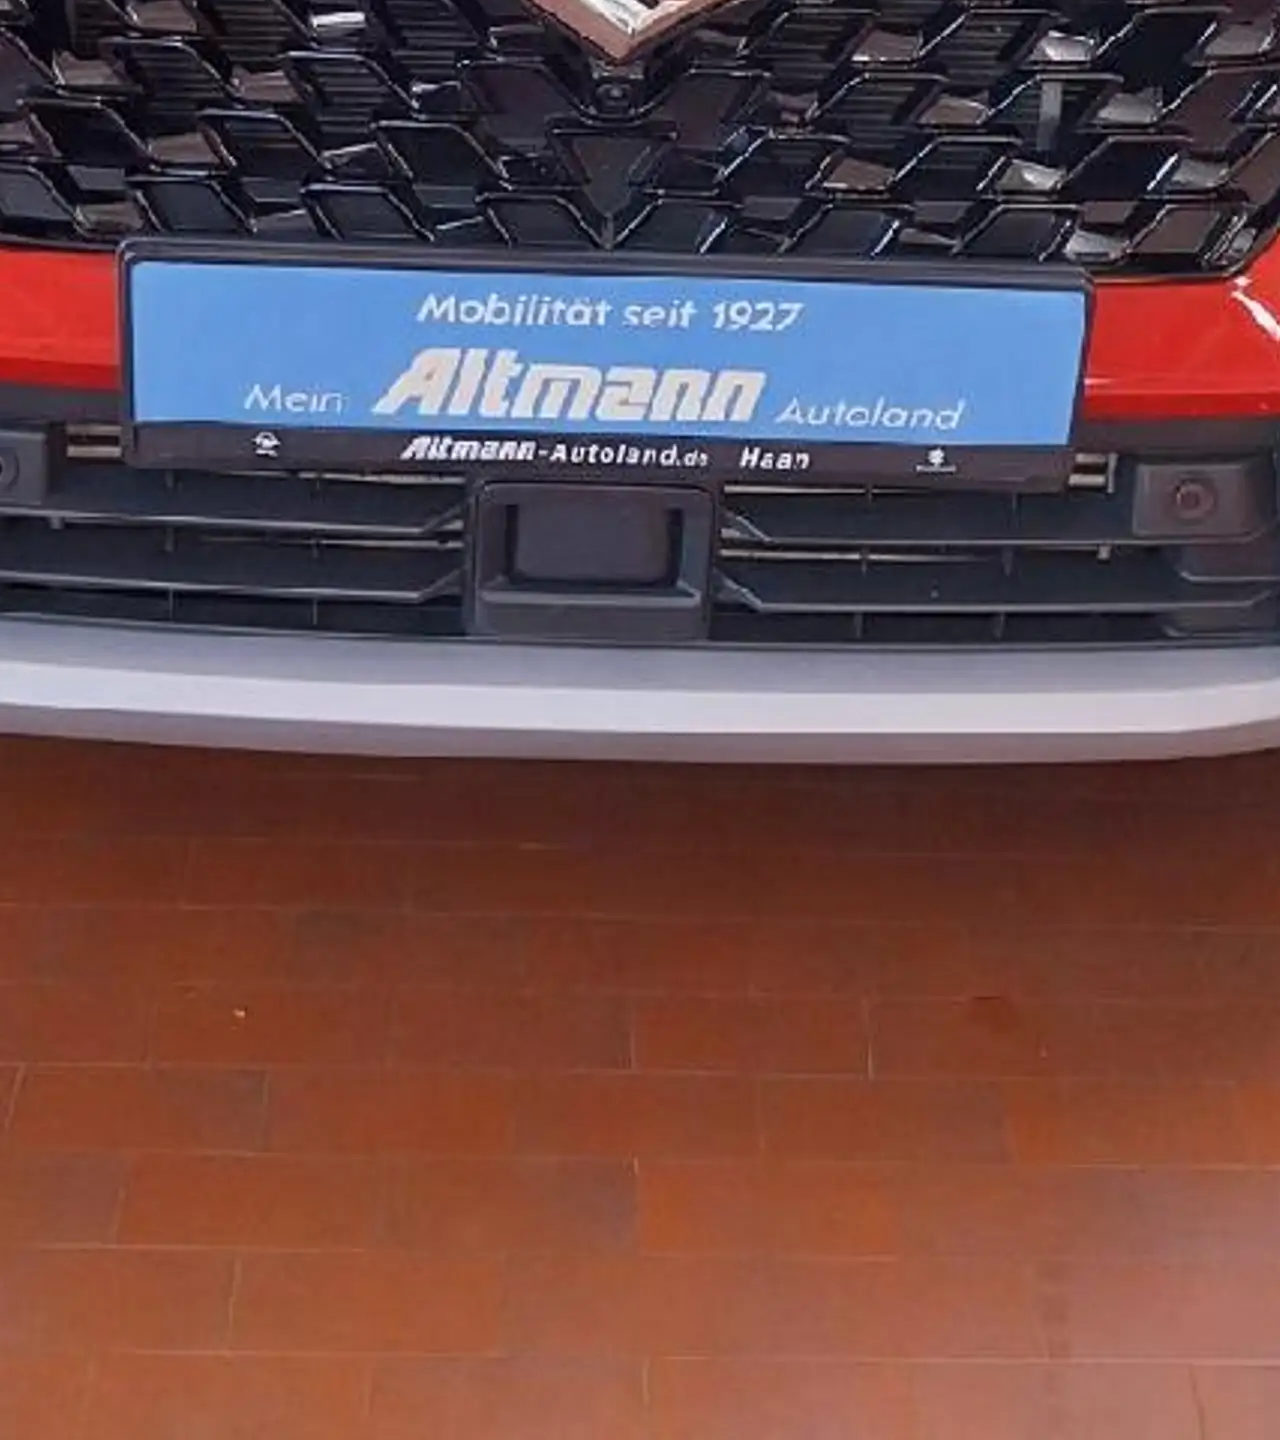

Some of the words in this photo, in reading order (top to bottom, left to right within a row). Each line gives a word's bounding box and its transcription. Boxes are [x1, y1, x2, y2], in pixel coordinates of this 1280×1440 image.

[417, 293, 613, 326] Mobilität
[622, 300, 697, 328] seit
[712, 300, 804, 331] 1927
[244, 384, 344, 413] Mein
[372, 347, 767, 421] Altmann
[774, 397, 965, 430] Autoland
[739, 446, 810, 470] Haan
